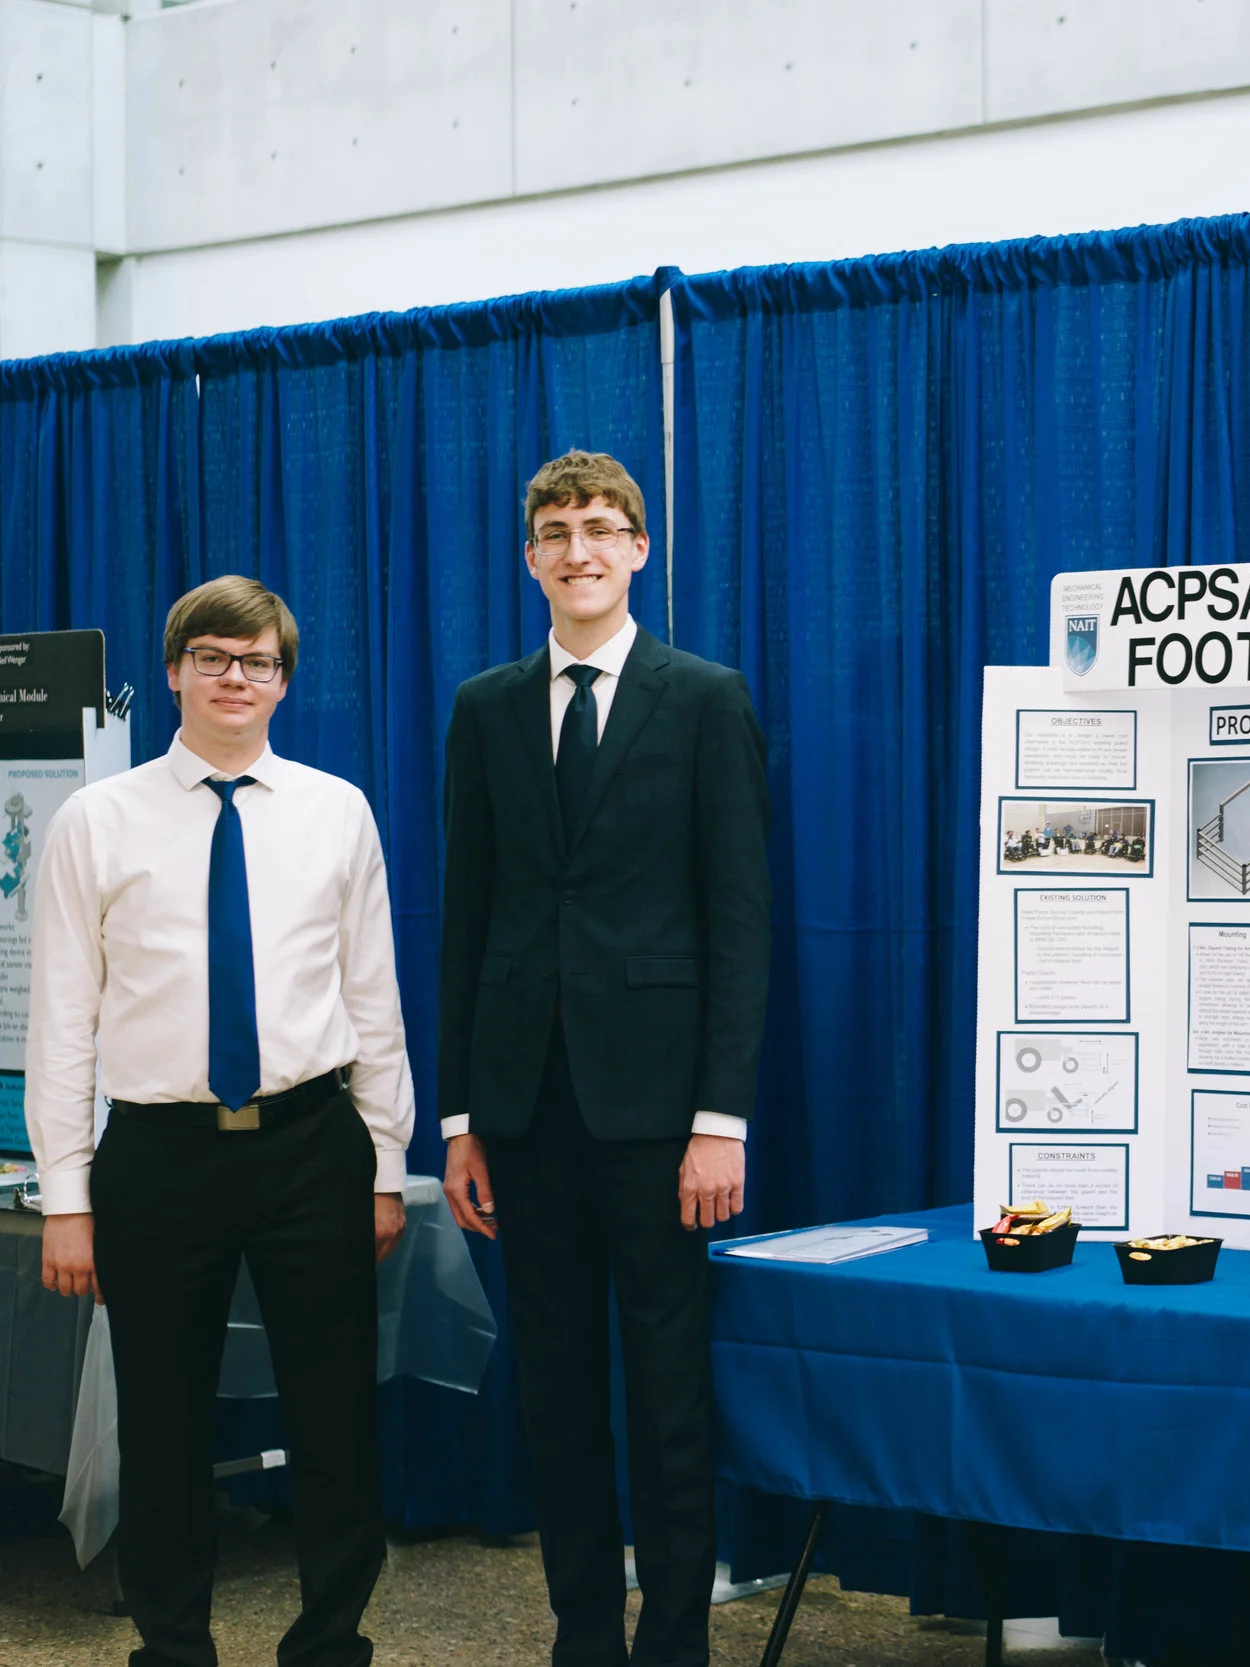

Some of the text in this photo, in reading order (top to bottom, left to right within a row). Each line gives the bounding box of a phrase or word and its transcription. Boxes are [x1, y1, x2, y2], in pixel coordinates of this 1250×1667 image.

[1068, 619, 1097, 632] NAIT
[19, 688, 48, 702] Module
[1051, 717, 1102, 726] OBJECTIVES
[8, 769, 79, 779] PROPOSED SOLUTION
[1039, 894, 1108, 902] EXISTING SOLUTION
[1218, 931, 1248, 940] Mounting
[1037, 1152, 1096, 1160] CONSTRAINTS
